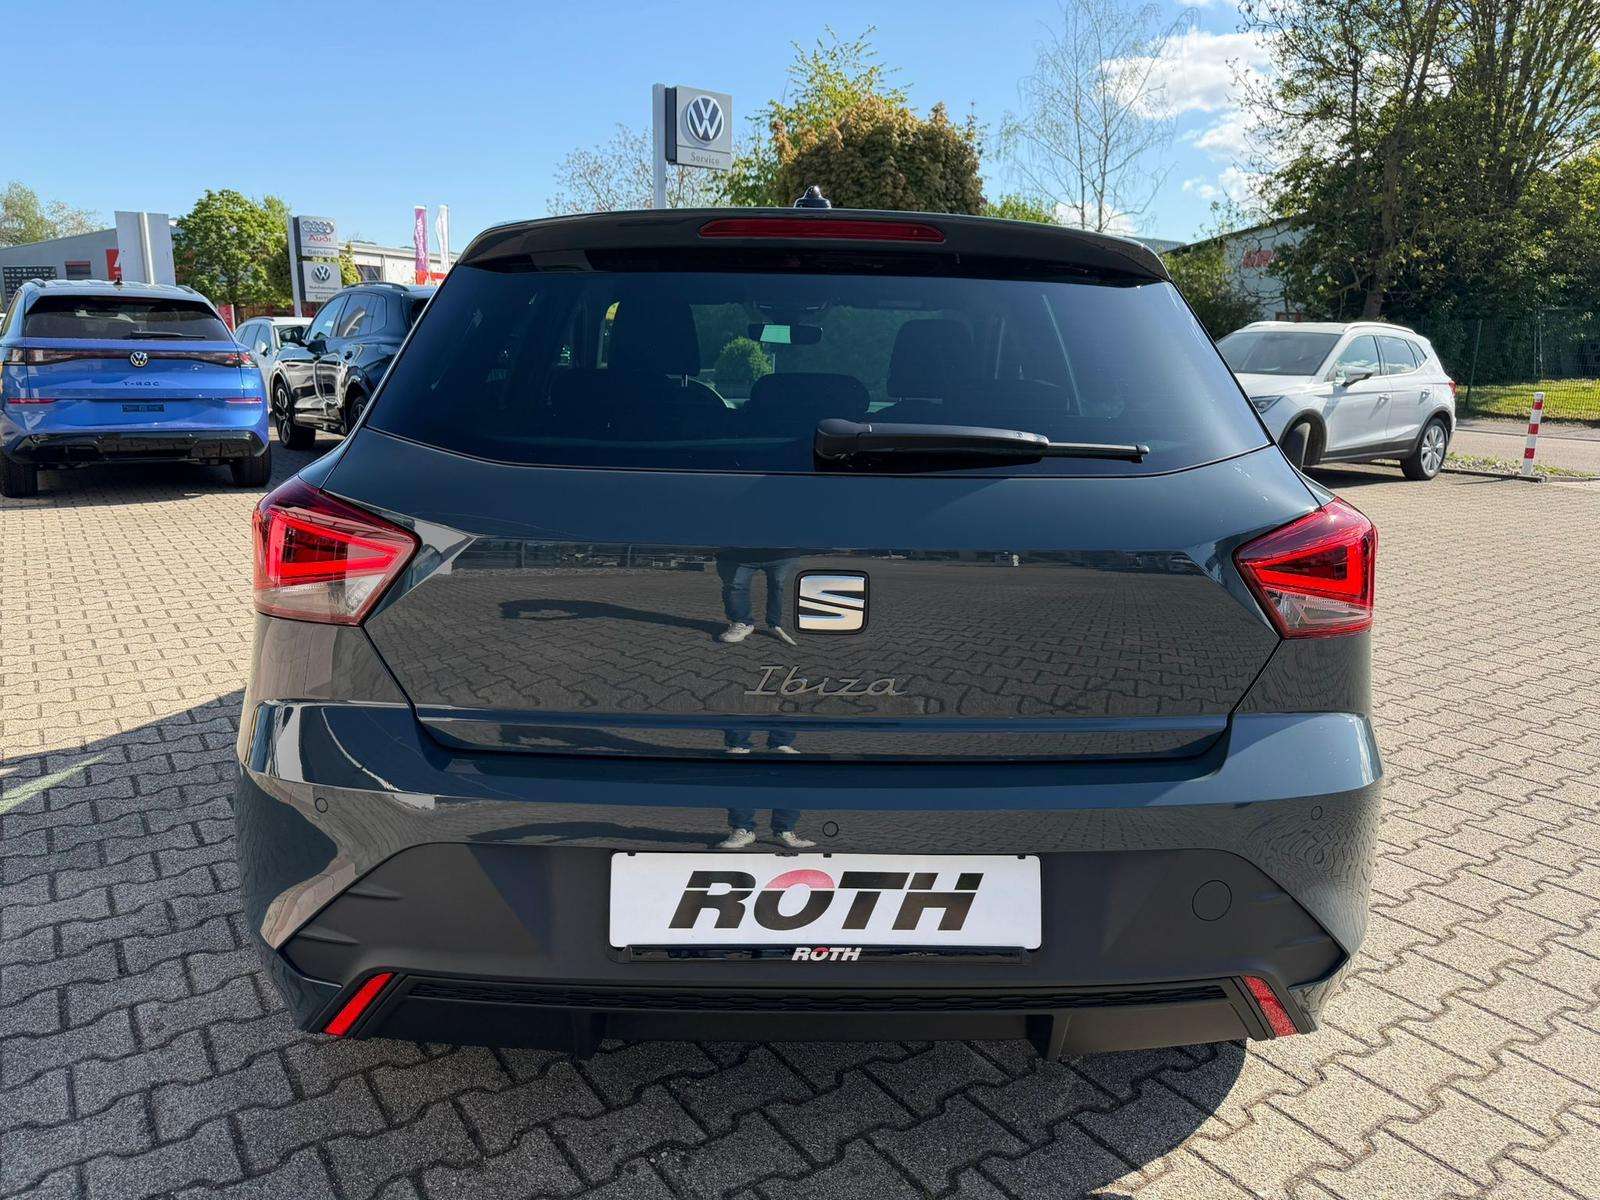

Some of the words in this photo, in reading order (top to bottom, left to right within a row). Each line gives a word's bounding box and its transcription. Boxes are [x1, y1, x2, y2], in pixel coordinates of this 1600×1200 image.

[690, 151, 720, 165] Service
[309, 234, 331, 243] Audi
[744, 664, 908, 697] Ibiza
[668, 868, 985, 932] ROTH
[791, 946, 862, 962] ROTH
